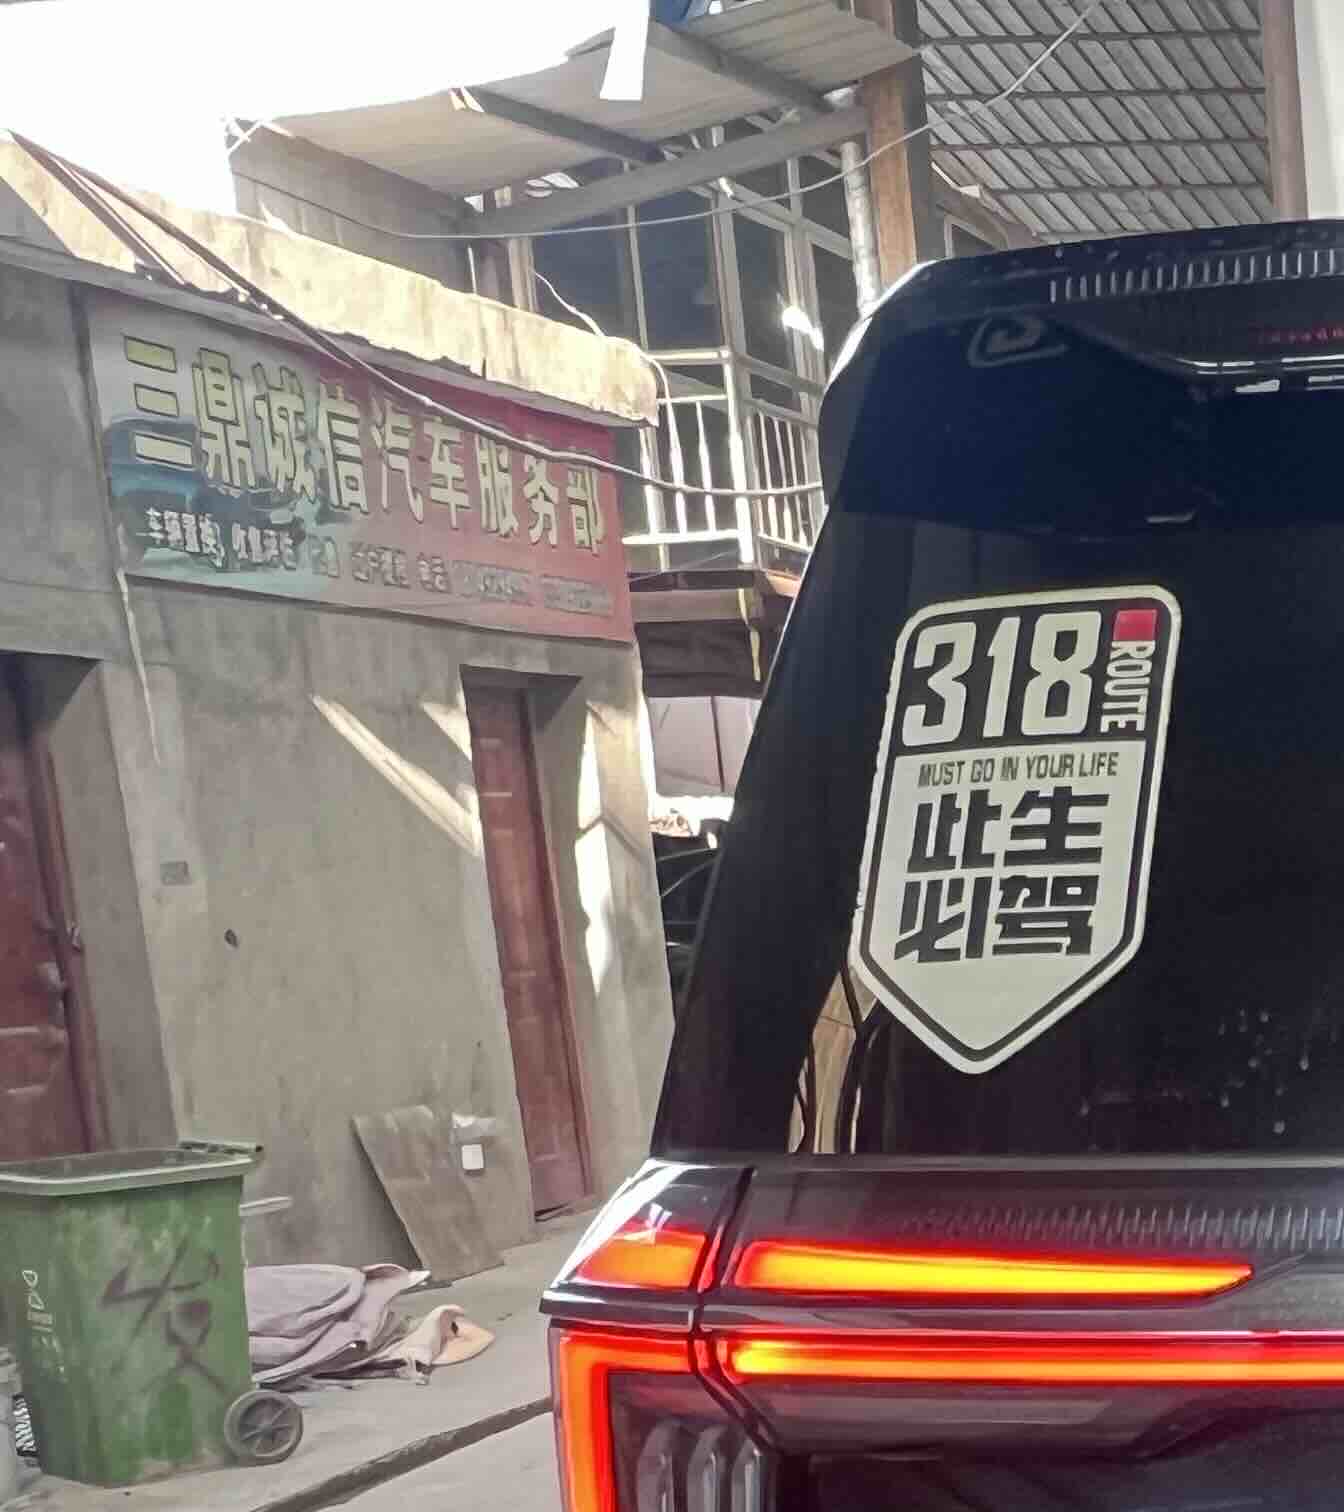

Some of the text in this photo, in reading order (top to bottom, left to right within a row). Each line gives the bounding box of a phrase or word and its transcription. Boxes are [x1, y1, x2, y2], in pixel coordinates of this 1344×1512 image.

[902, 611, 1101, 746] 318
[1100, 640, 1156, 733] ROUTE
[918, 752, 1119, 788] MUST GO IN YOUR LIFE
[907, 786, 1109, 873] 此生
[894, 874, 1099, 963] 必驾
